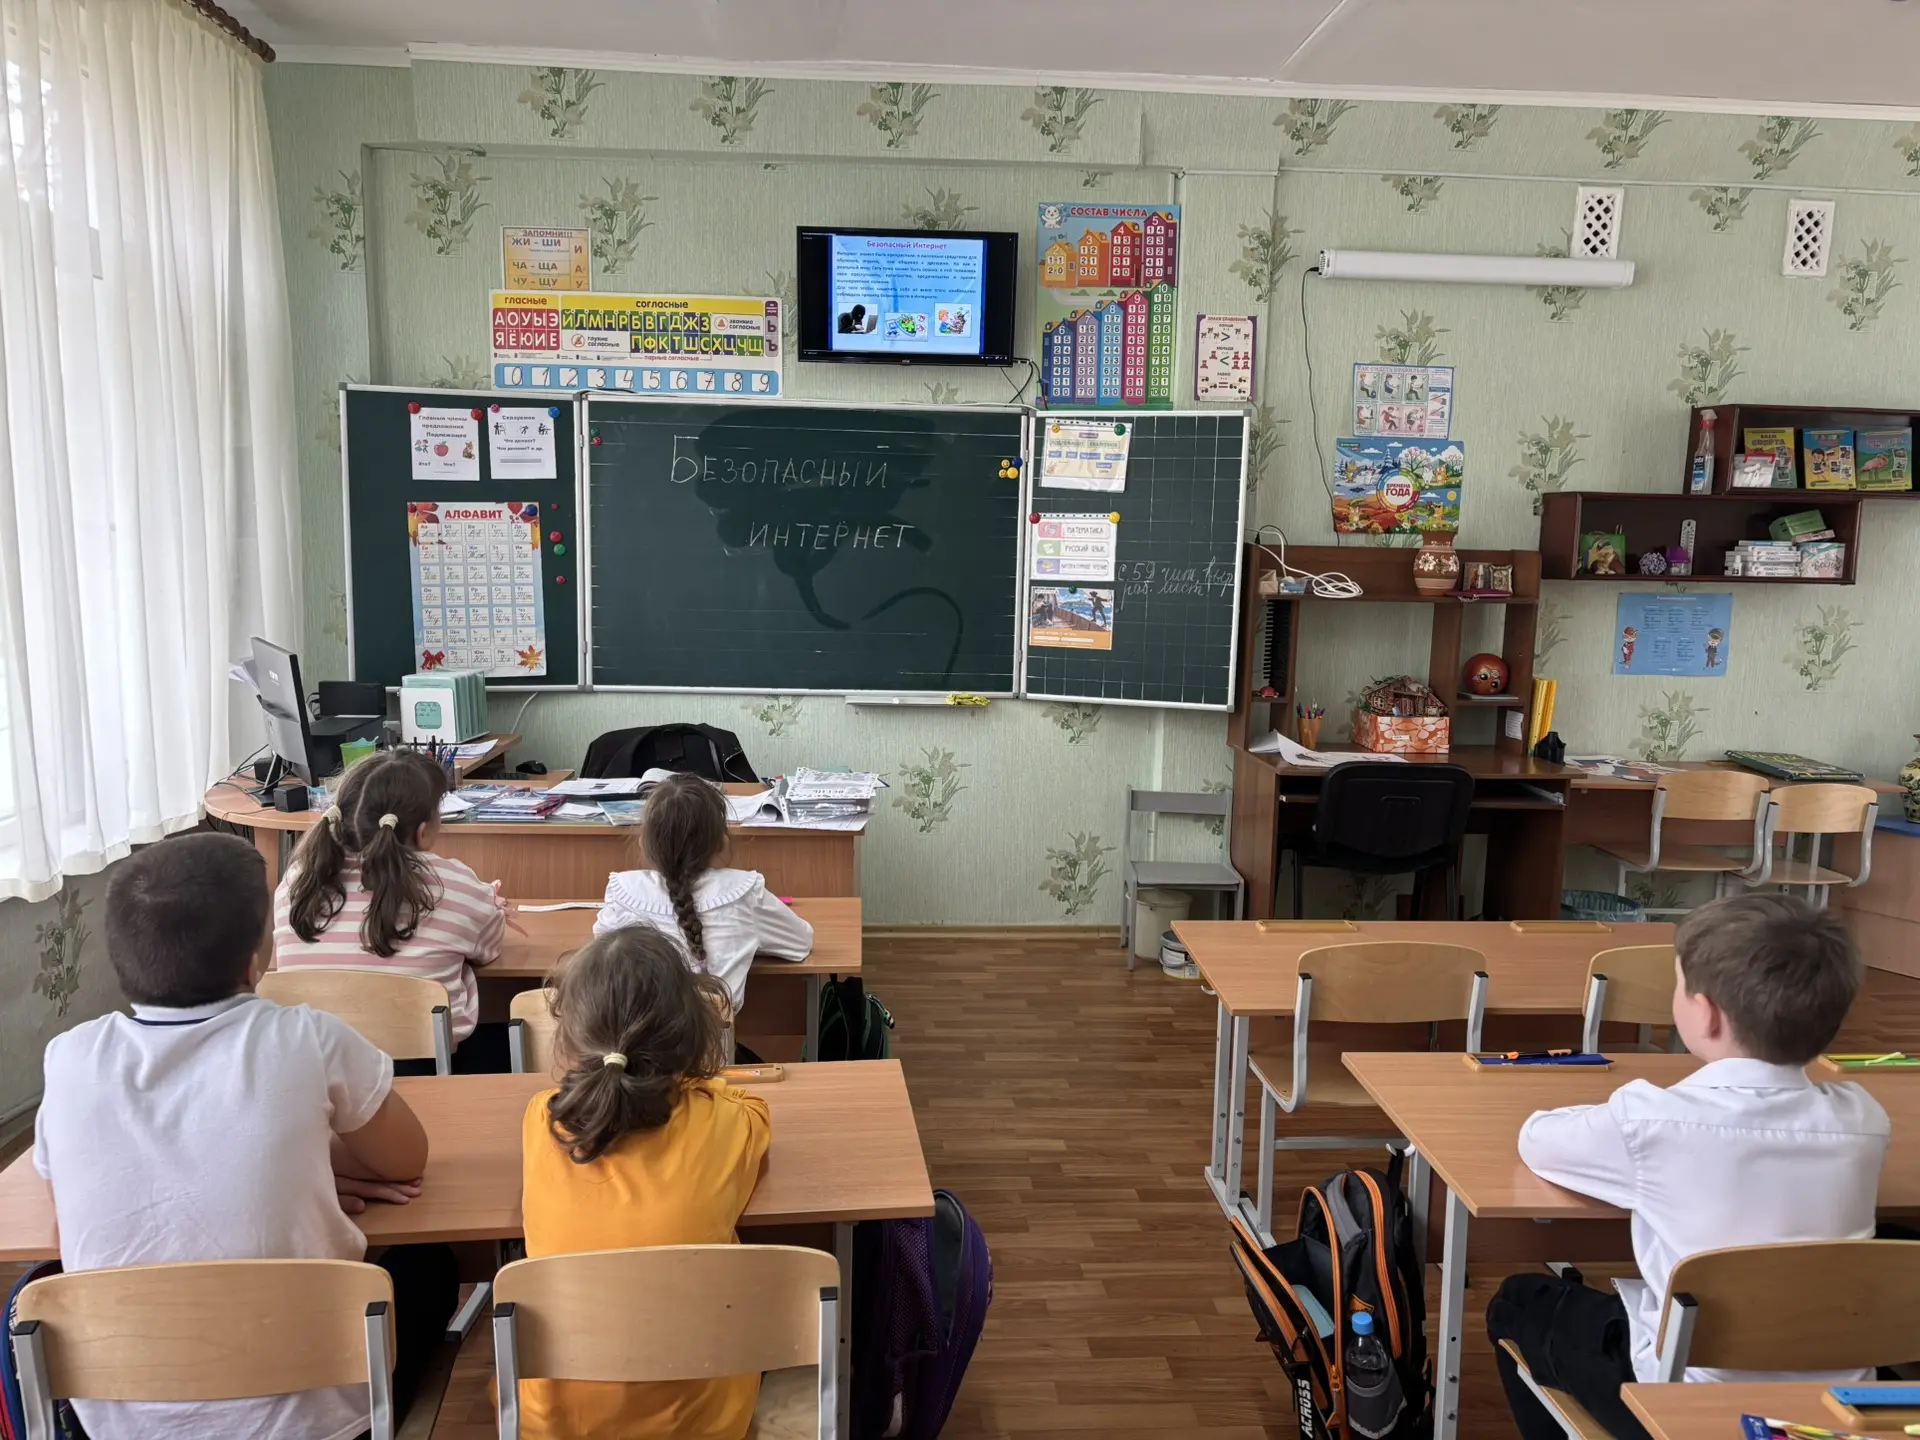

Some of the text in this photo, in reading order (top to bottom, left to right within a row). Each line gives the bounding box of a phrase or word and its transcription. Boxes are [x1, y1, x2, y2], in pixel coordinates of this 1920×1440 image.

[1071, 208, 1148, 216] СОСТАВ ЧИСЛА
[575, 245, 582, 253] И
[913, 242, 947, 250] Интернет
[512, 367, 769, 392] 0 1 2 3 4 5 6 7 8 9
[1386, 488, 1410, 497] ГОДА
[444, 510, 502, 519] АЛФАВИТ
[750, 522, 915, 550] ИНТЕРНЕТ
[1132, 560, 1156, 580] 59
[1298, 1379, 1313, 1439] ACROSS
